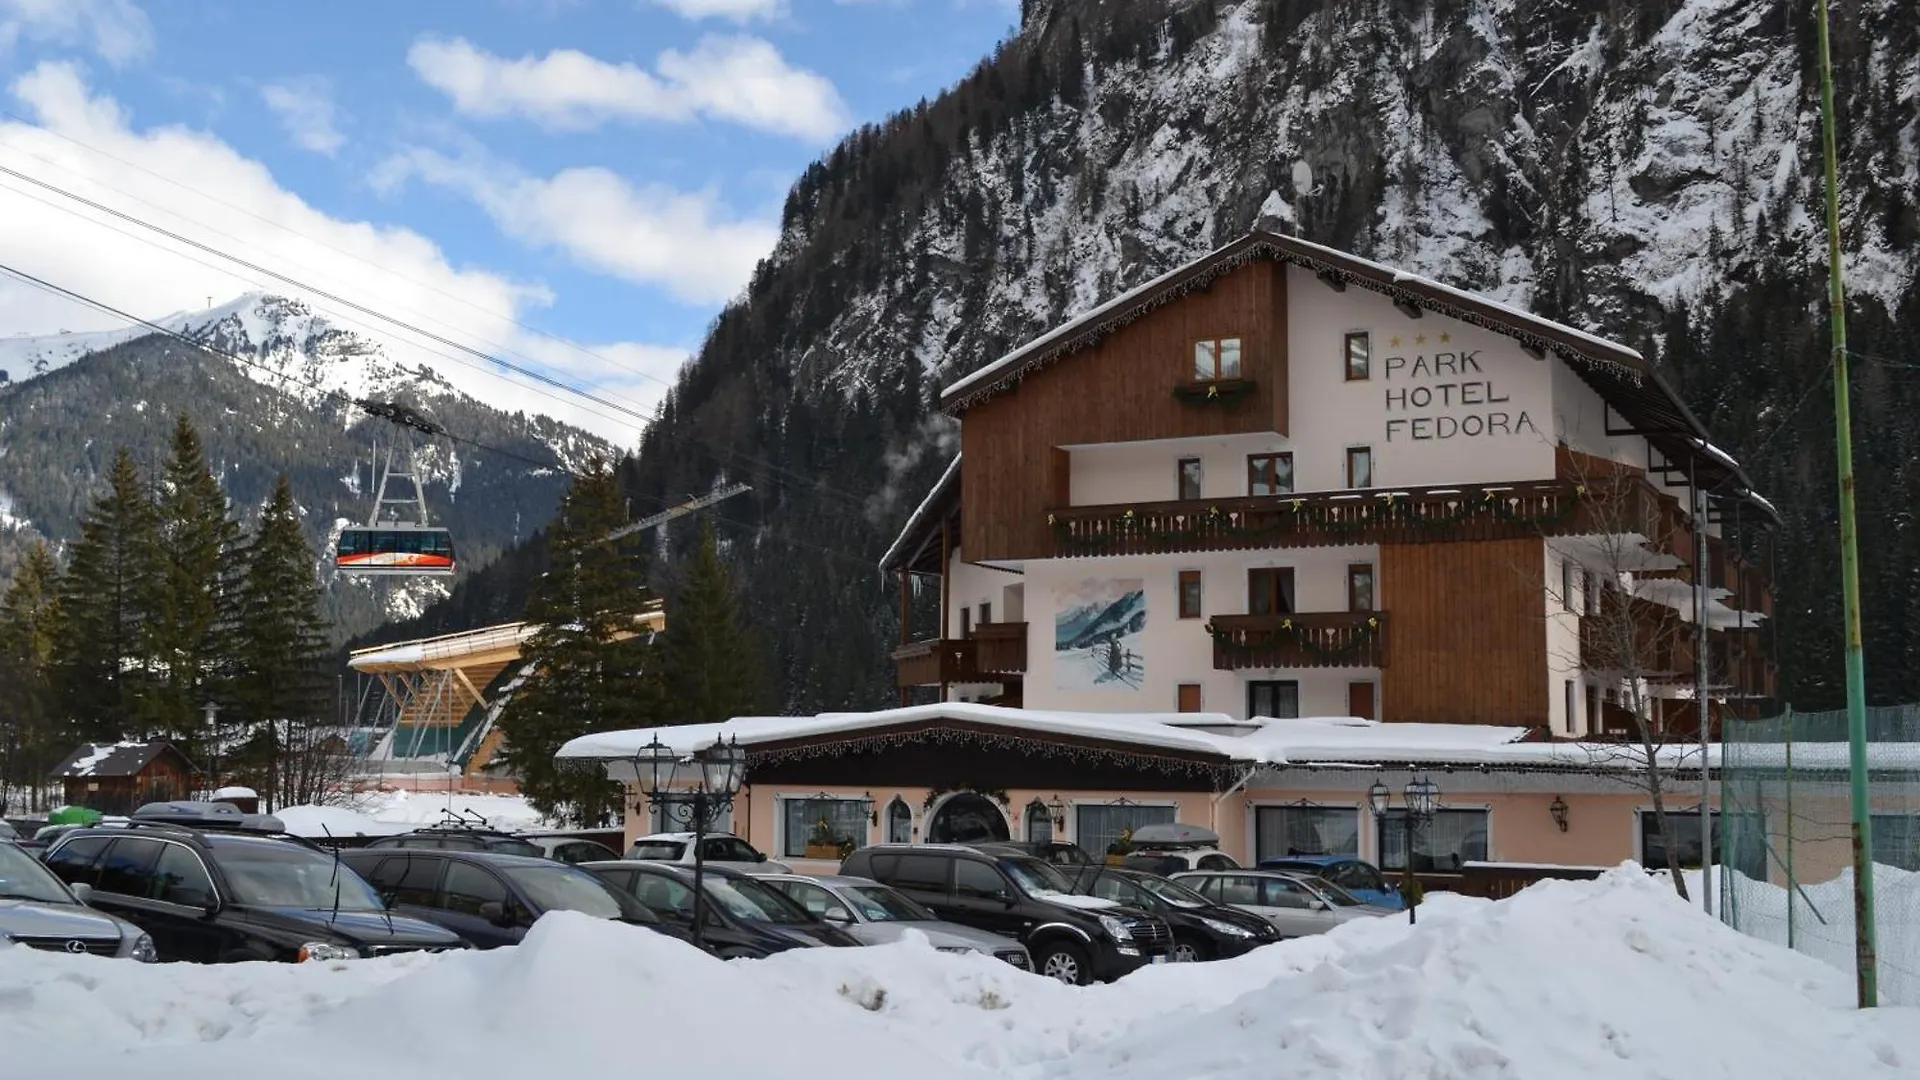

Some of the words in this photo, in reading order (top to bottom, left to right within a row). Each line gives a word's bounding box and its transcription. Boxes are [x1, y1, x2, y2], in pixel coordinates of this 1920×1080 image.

[1385, 350, 1483, 379] PARK
[1385, 381, 1510, 411] HOTEL
[1385, 411, 1536, 442] FEDORA
